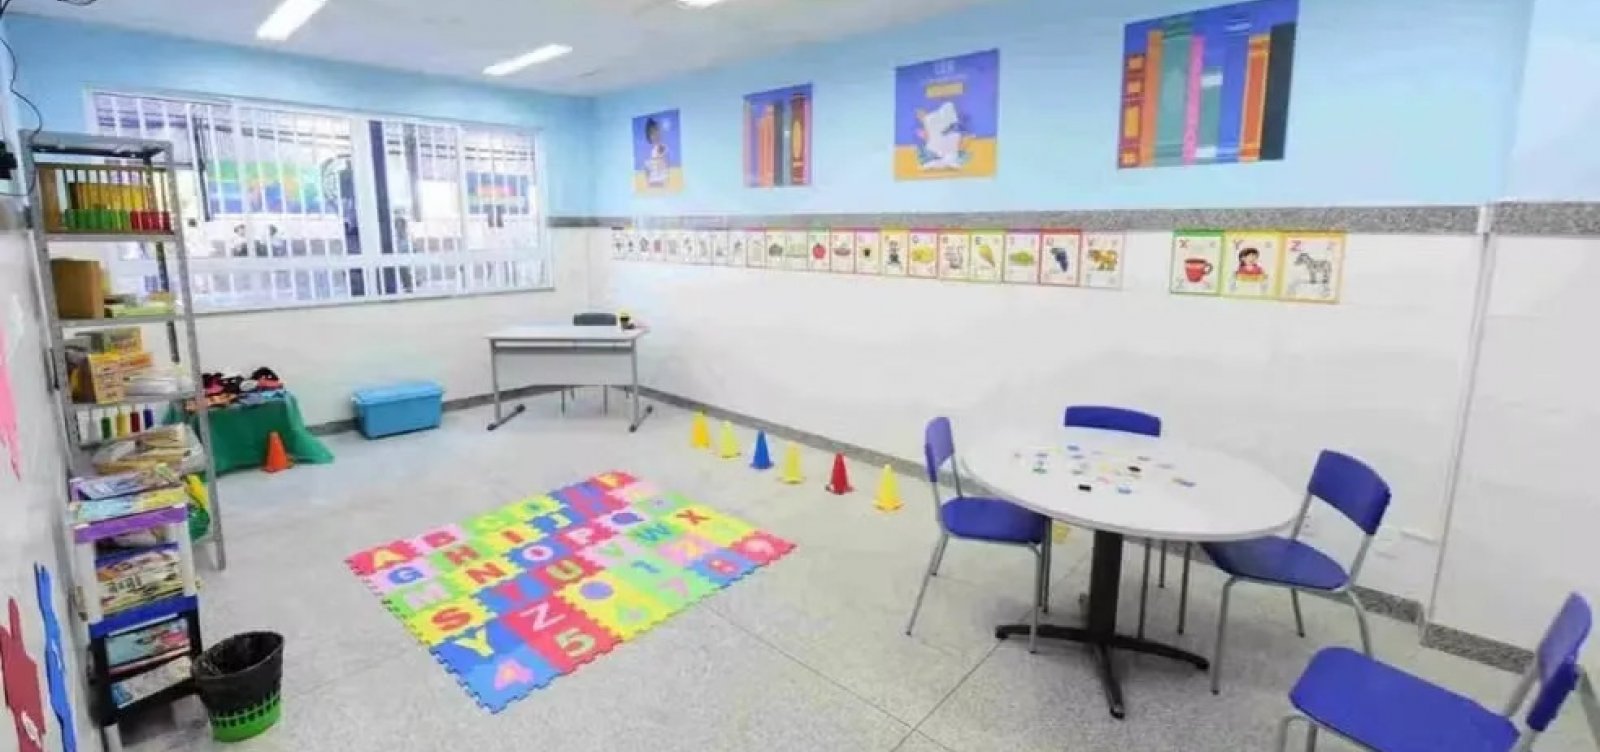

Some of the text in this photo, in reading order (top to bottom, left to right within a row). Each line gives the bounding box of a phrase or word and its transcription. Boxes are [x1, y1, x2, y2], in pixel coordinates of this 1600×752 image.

[1289, 239, 1302, 251] Z
[372, 548, 408, 569] A
[387, 566, 424, 584] G
[445, 546, 479, 565] H
[501, 529, 525, 545] I
[431, 607, 471, 631] S
[547, 561, 582, 580] U
[636, 522, 672, 542] W
[675, 510, 711, 525] X
[465, 562, 506, 584] N
[522, 545, 553, 562] O
[453, 628, 495, 657] Y
[520, 602, 567, 631] Z
[555, 628, 595, 657] 5
[706, 559, 739, 576] 8
